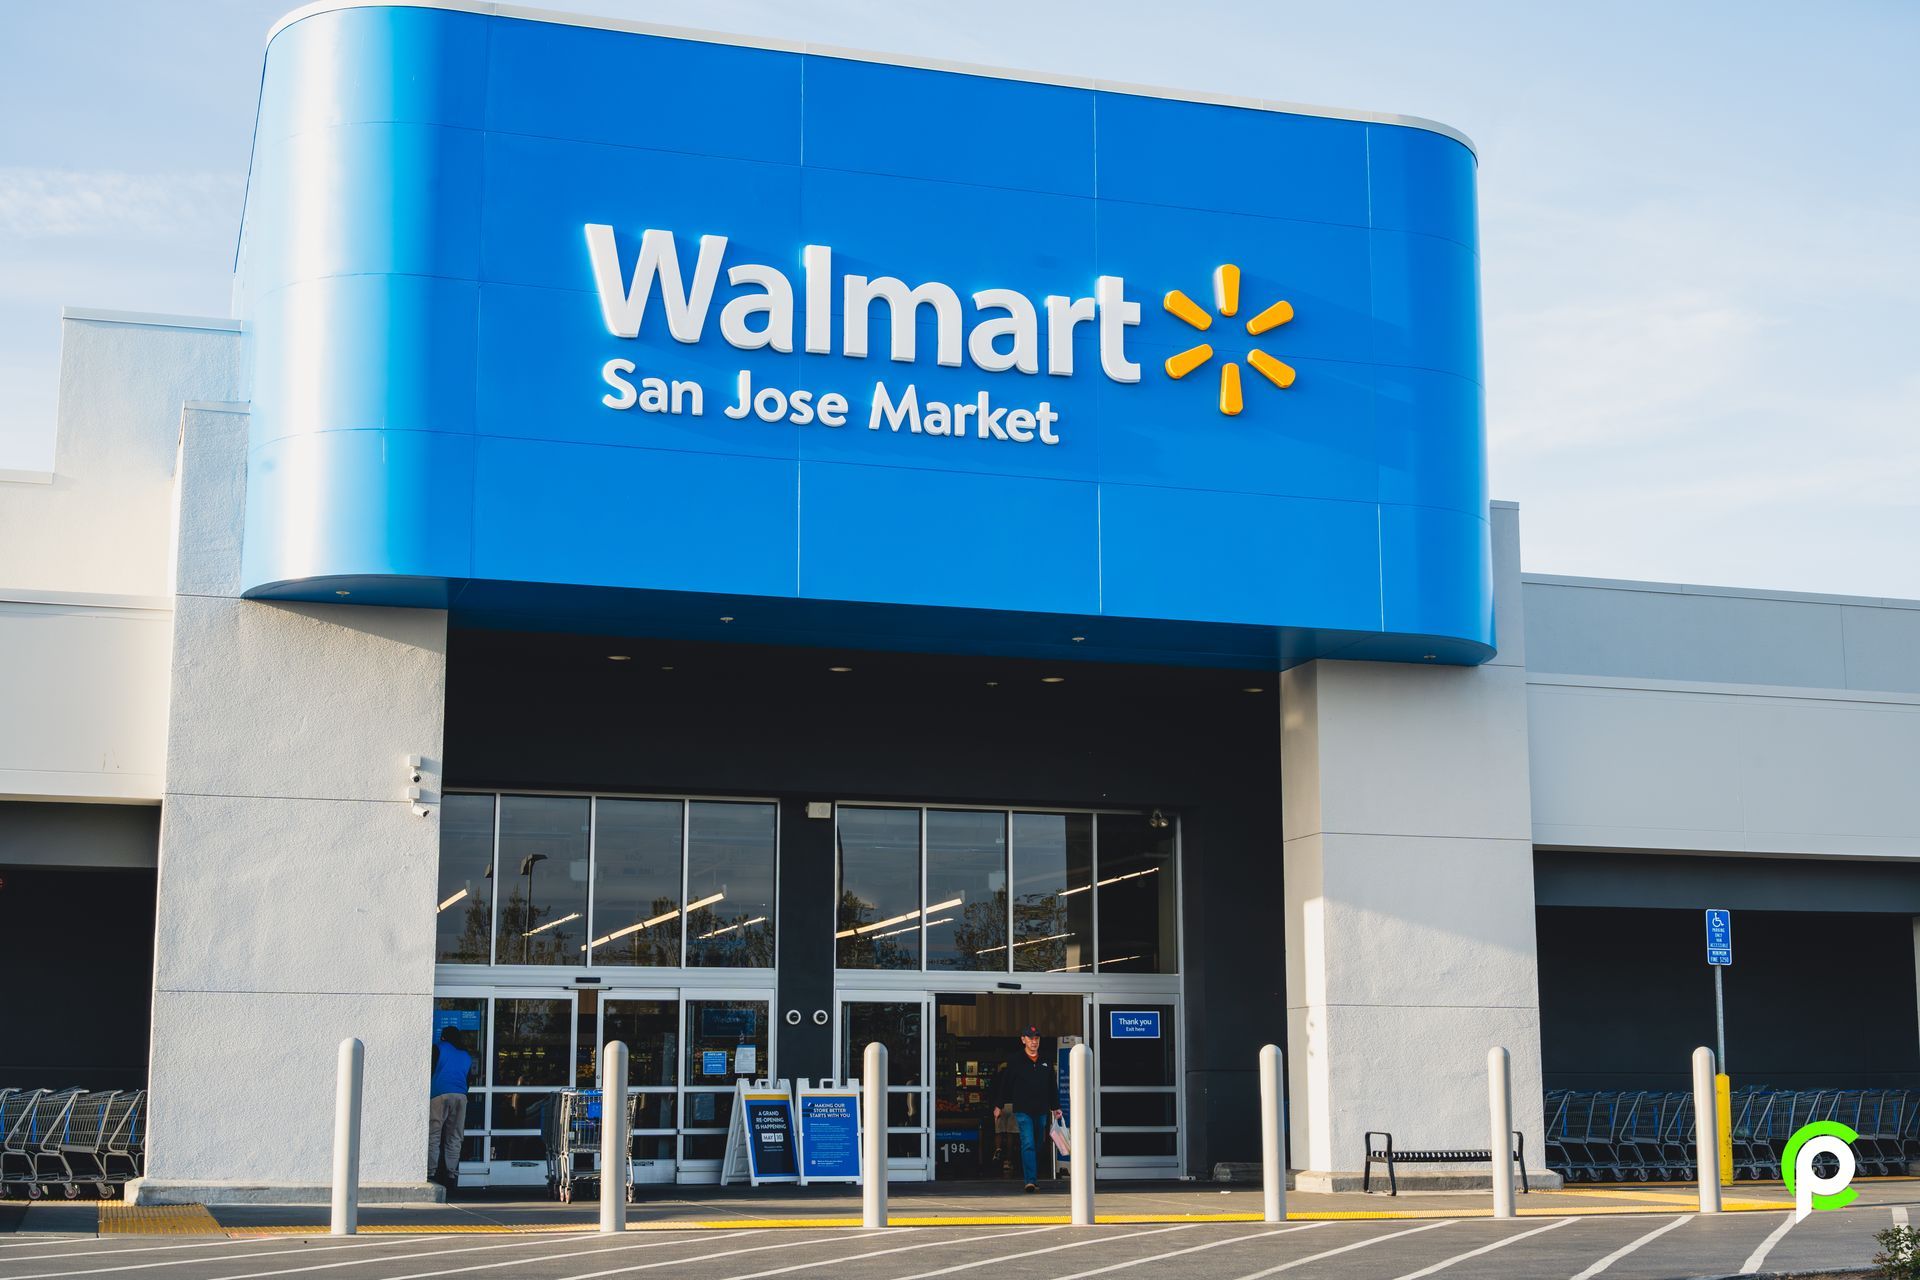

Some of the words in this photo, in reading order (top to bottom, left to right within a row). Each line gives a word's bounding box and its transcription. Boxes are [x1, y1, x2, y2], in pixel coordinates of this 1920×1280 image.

[585, 222, 1141, 383] Walmart
[602, 358, 705, 416] San
[723, 369, 849, 427] Jose
[868, 380, 1060, 445] Market
[1118, 1017, 1139, 1025] Thank
[1139, 1019, 1152, 1027] you
